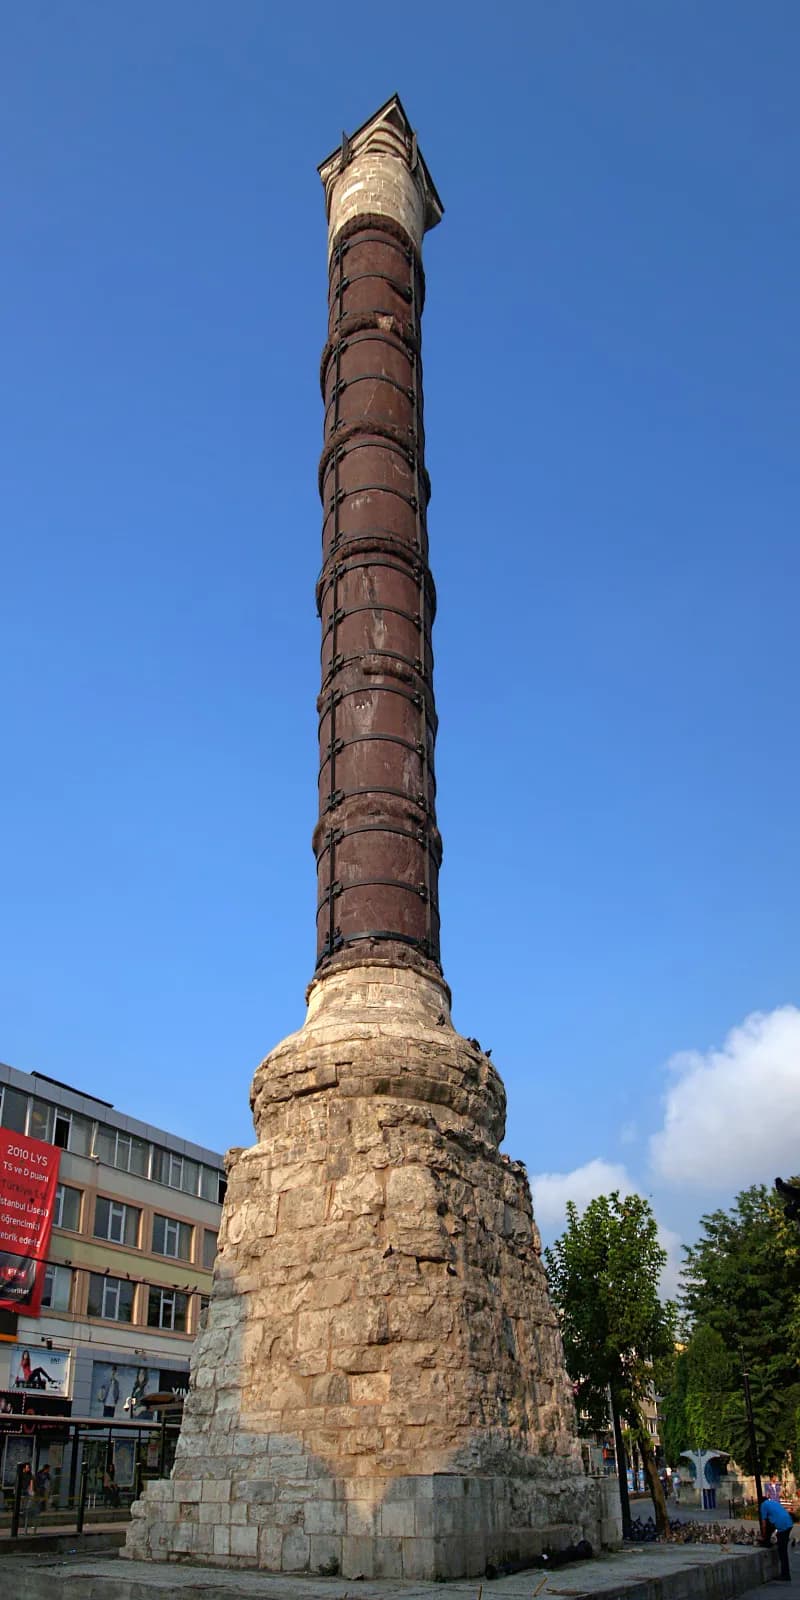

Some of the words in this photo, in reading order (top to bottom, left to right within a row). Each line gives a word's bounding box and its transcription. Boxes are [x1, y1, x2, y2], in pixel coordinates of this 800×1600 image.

[8, 1144, 29, 1160] 2010
[30, 1152, 48, 1166] LYS
[3, 1160, 13, 1171] TS
[14, 1166, 23, 1174] ve
